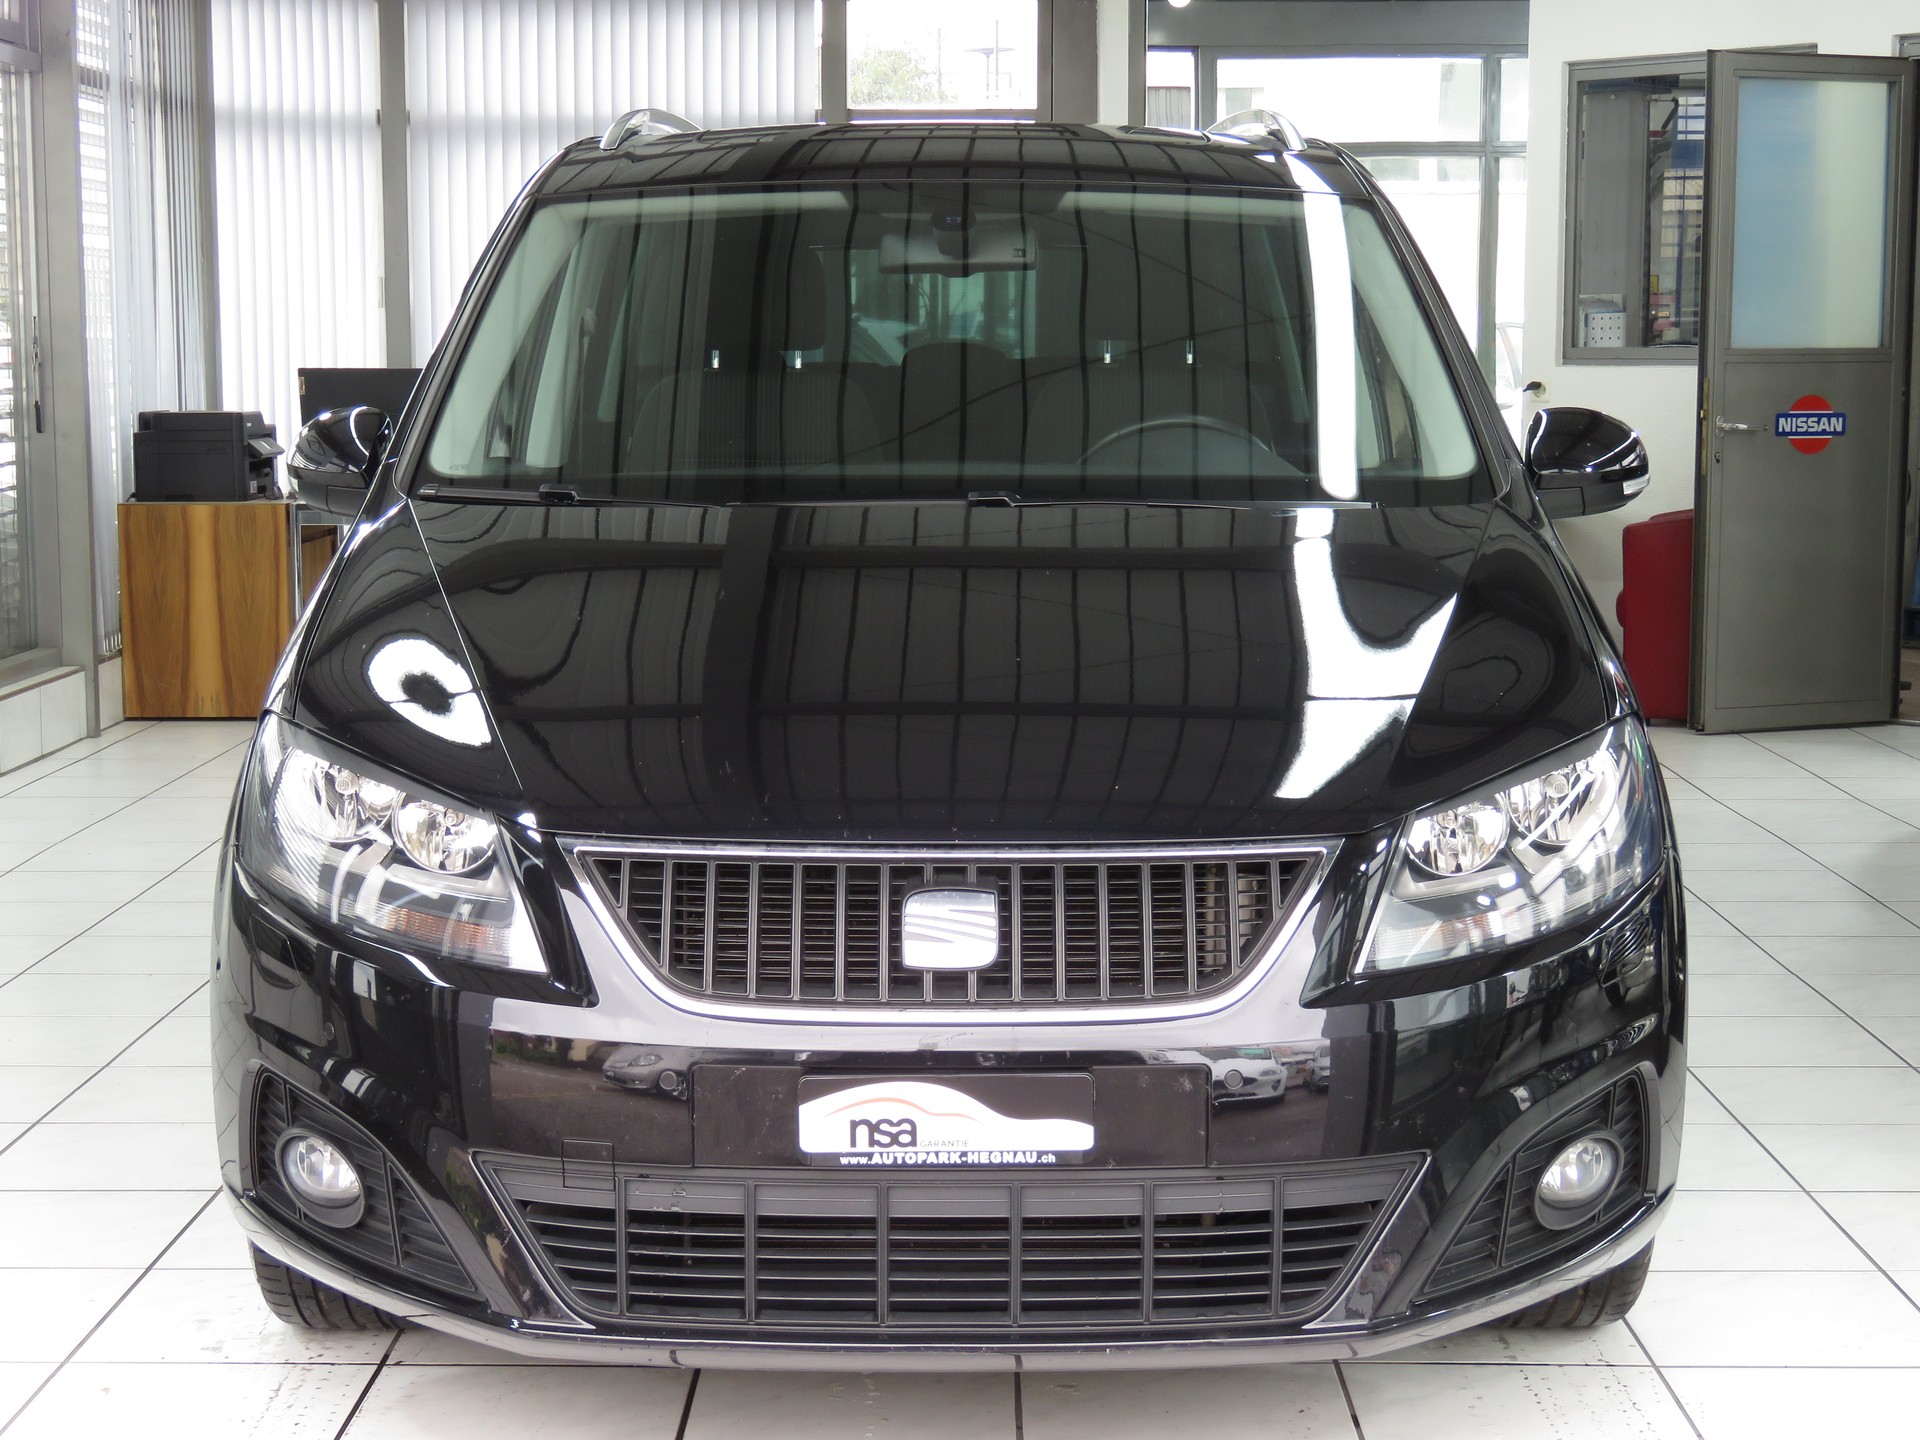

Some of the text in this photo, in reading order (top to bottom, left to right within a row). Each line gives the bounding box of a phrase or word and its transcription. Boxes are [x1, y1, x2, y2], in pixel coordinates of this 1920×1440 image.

[1778, 417, 1843, 432] NISSAN
[850, 1118, 970, 1148] nsa GARANTIE
[839, 1151, 1056, 1165] www.AUTOPARK-HEGNAU.ch
